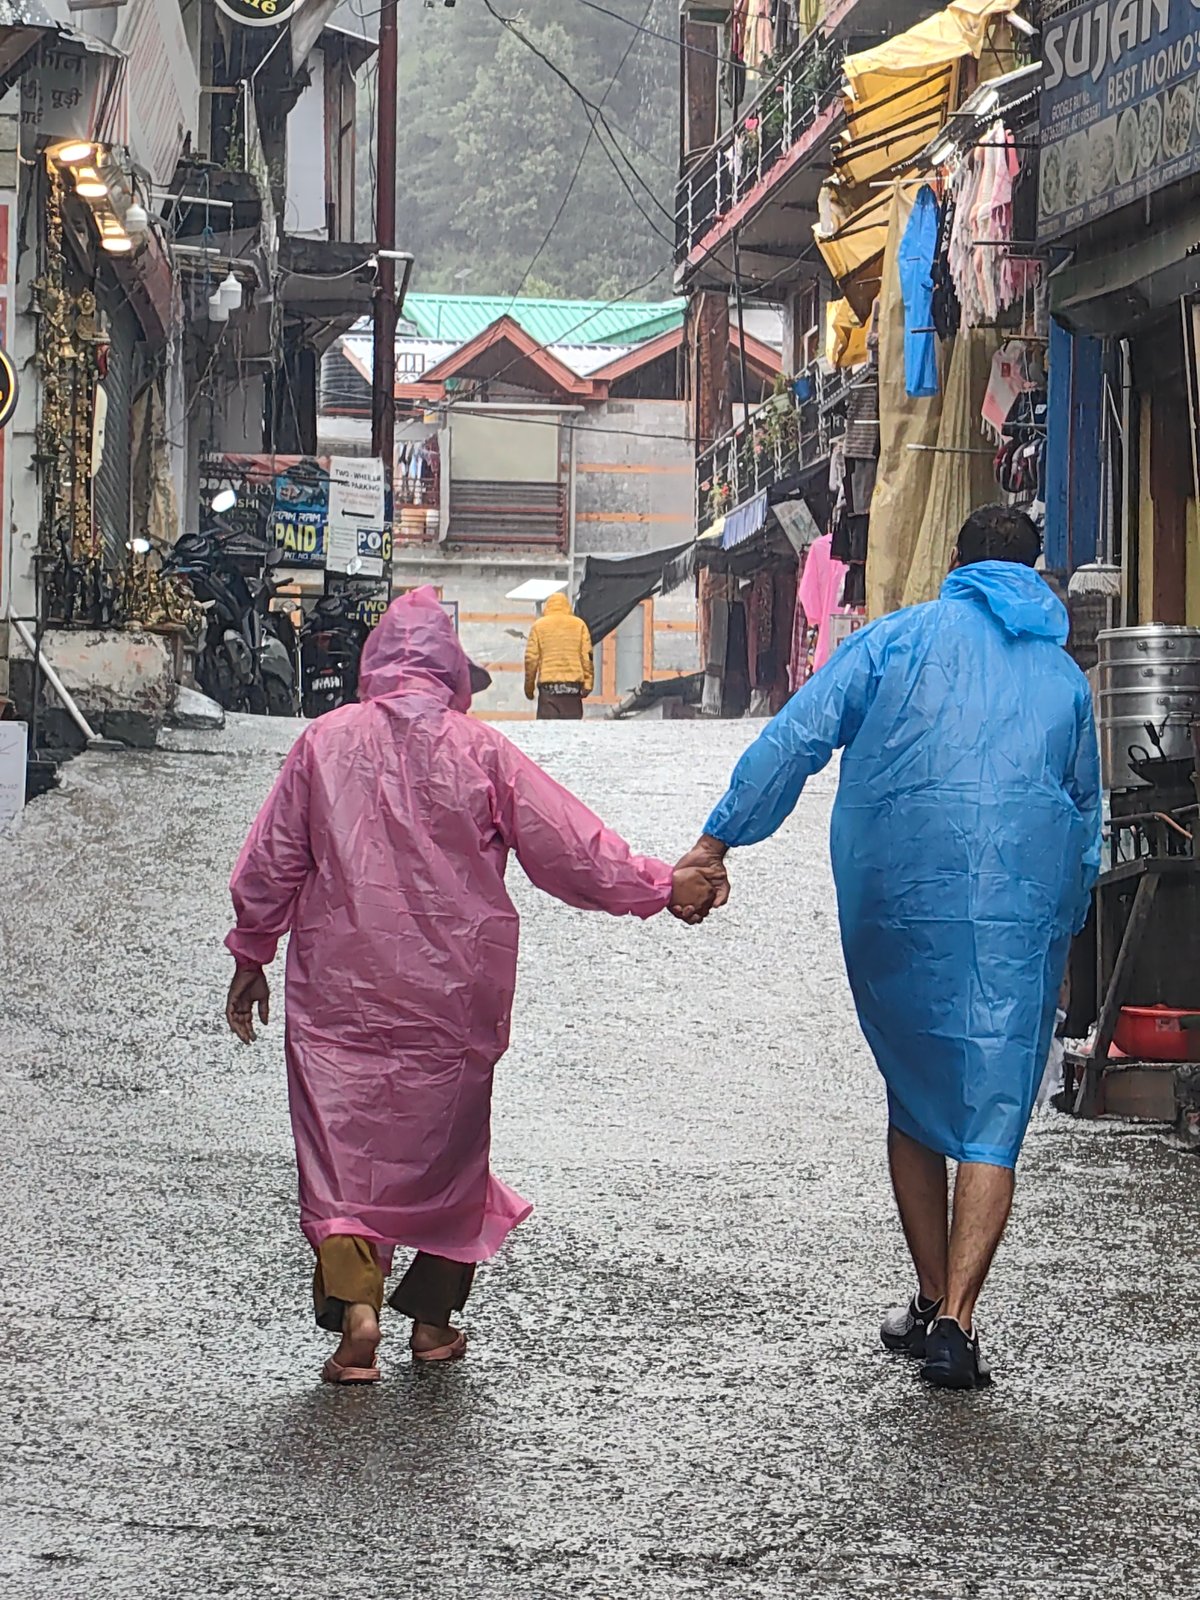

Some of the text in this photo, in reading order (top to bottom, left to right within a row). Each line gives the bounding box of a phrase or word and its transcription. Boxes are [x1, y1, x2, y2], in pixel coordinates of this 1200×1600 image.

[1107, 65, 1138, 109] BEST
[335, 469, 349, 478] TWO
[351, 481, 380, 492] PARKING
[298, 512, 321, 523] RAM
[275, 523, 316, 552] PAID
